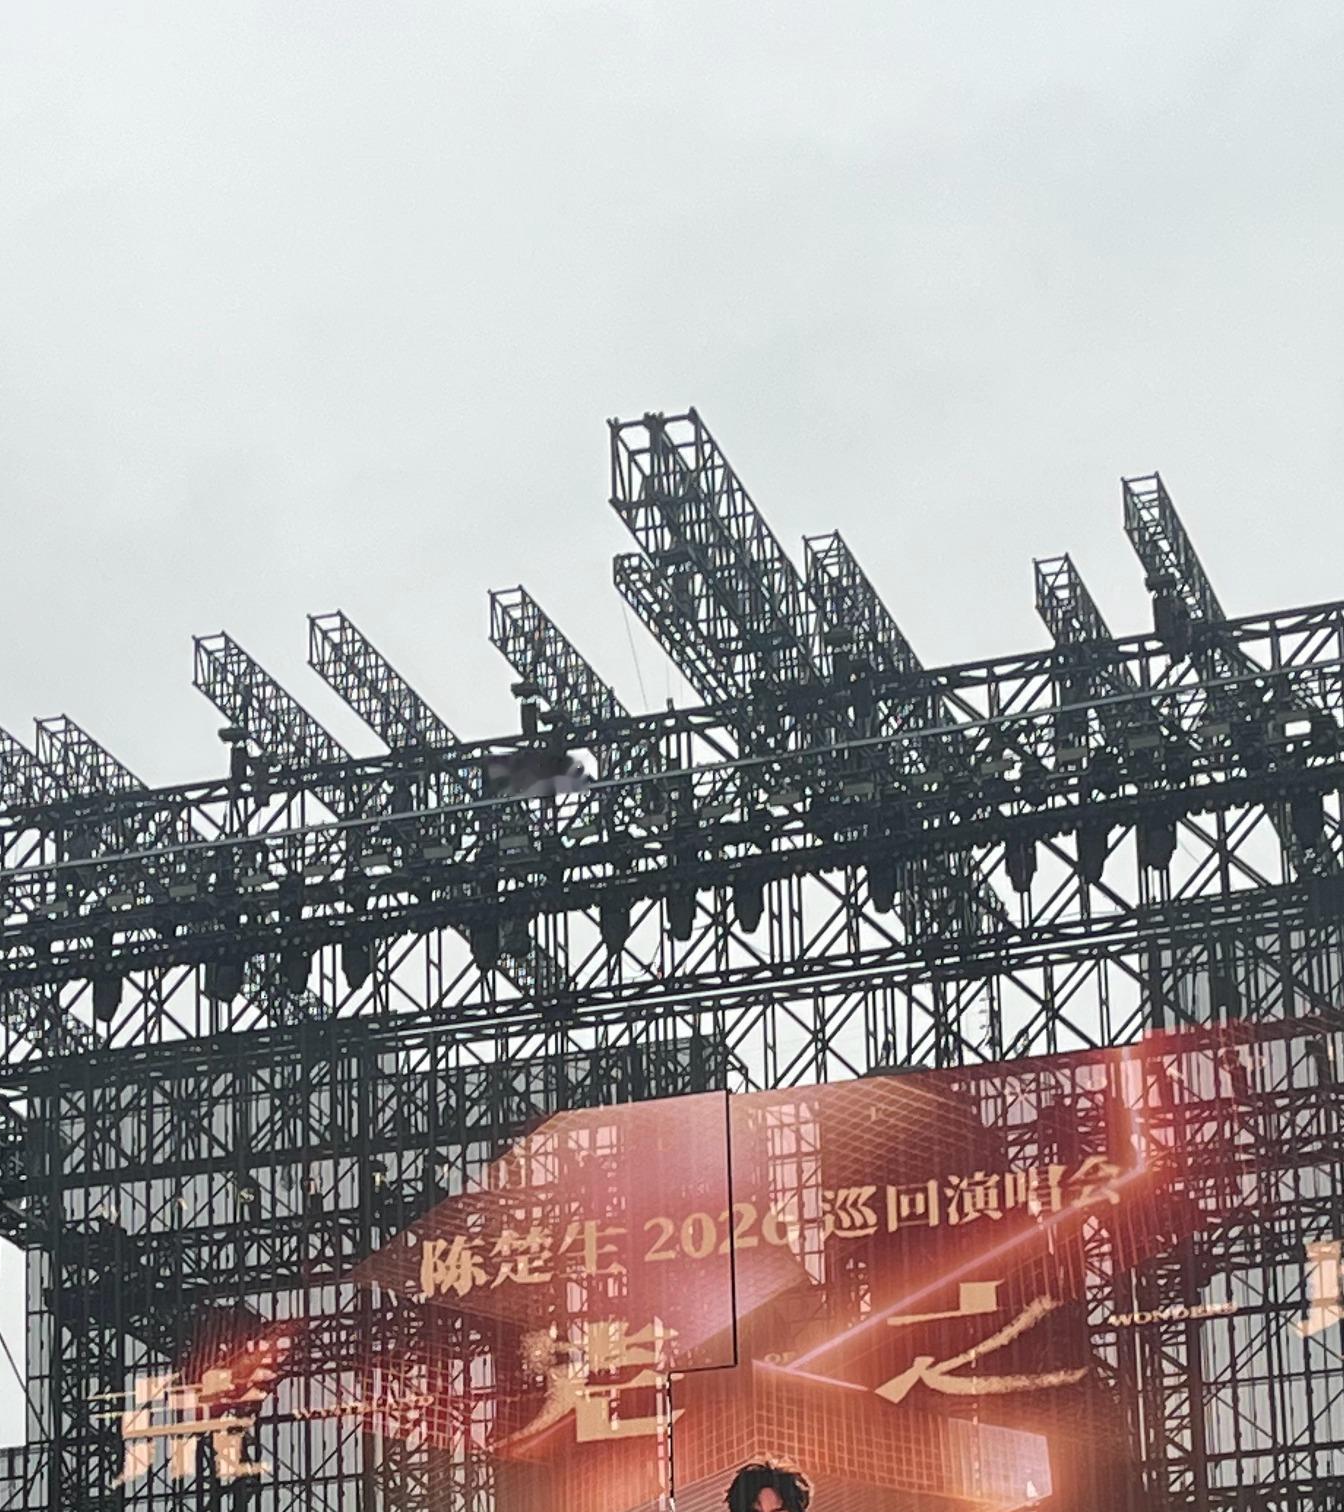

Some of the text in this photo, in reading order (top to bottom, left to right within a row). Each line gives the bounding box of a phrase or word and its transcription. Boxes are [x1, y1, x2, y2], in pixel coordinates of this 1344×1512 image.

[420, 1154, 1123, 1299] 陈楚生 2026 巡回演唱会
[868, 1279, 1089, 1403] 之
